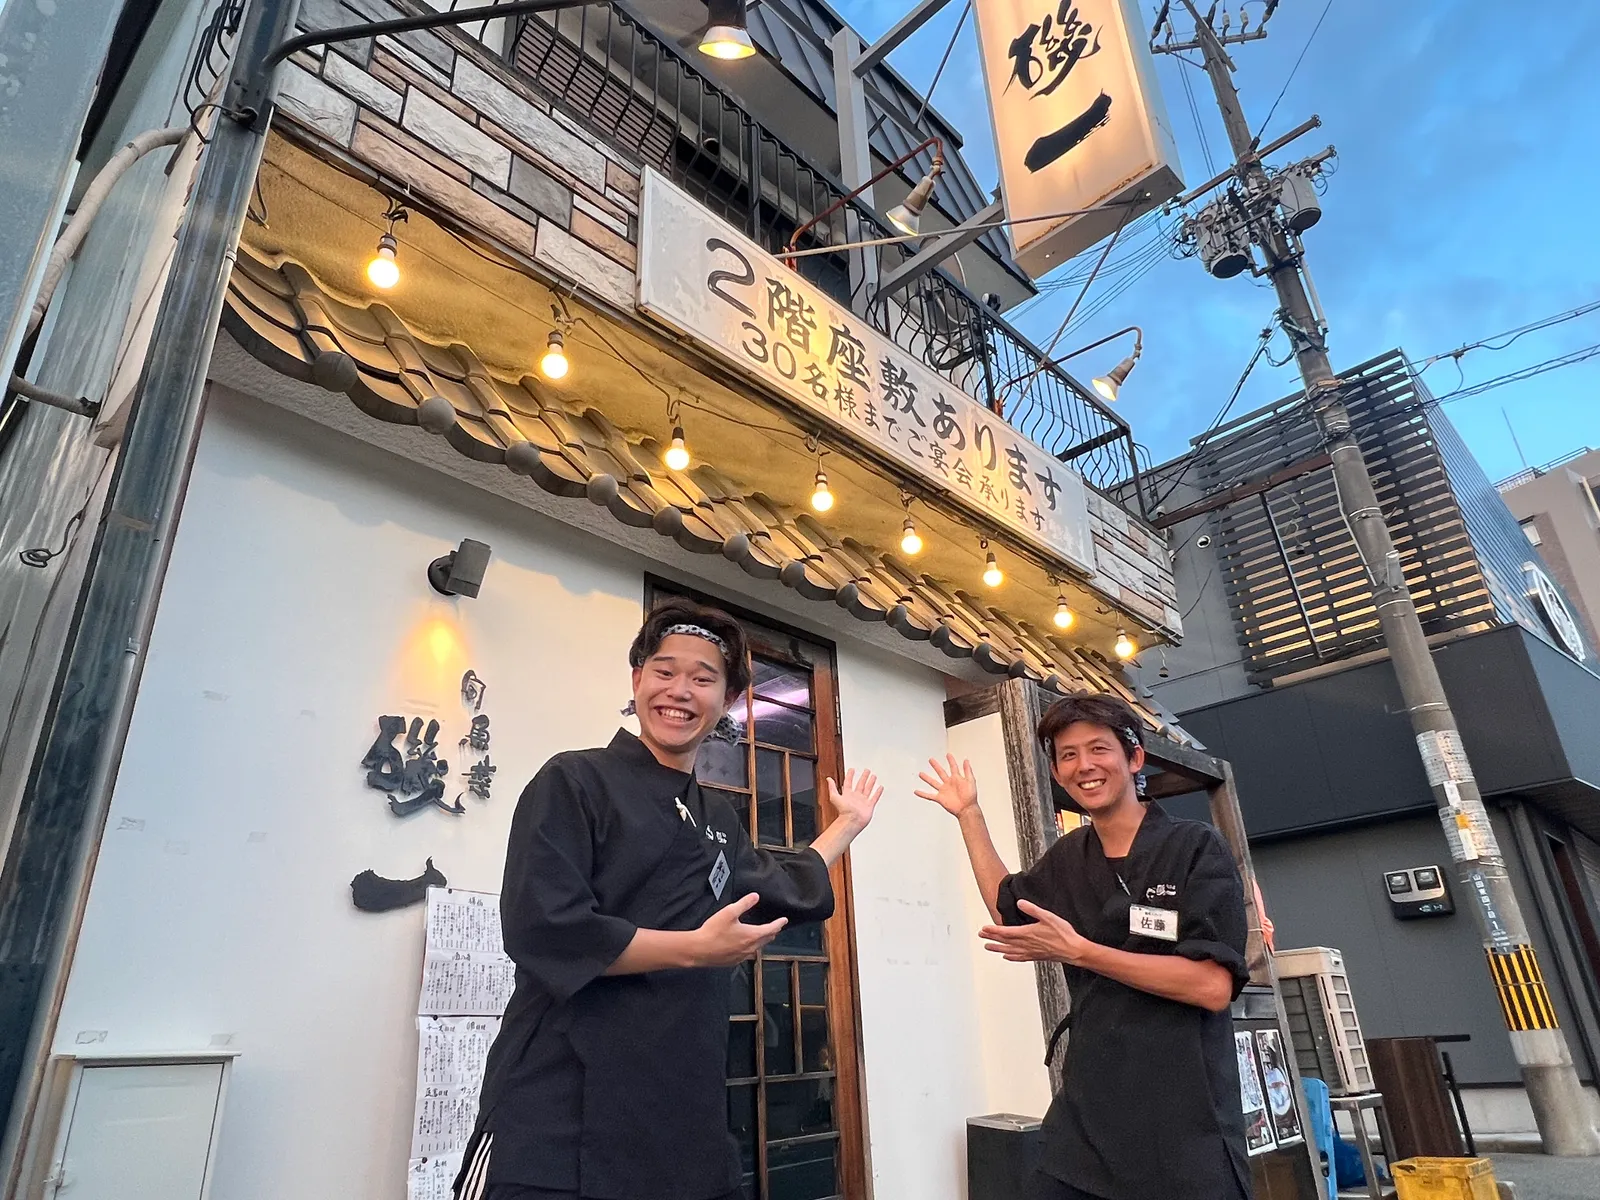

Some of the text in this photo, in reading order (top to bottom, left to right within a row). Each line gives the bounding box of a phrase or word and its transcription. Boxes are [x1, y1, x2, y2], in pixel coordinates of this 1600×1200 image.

[1002, 0, 1112, 174] 磯一
[706, 238, 1062, 511] 2階座敷あります
[741, 321, 1046, 533] 30名様までご宴会承ります
[350, 715, 466, 913] 磯一
[1141, 916, 1166, 932] 佐藤
